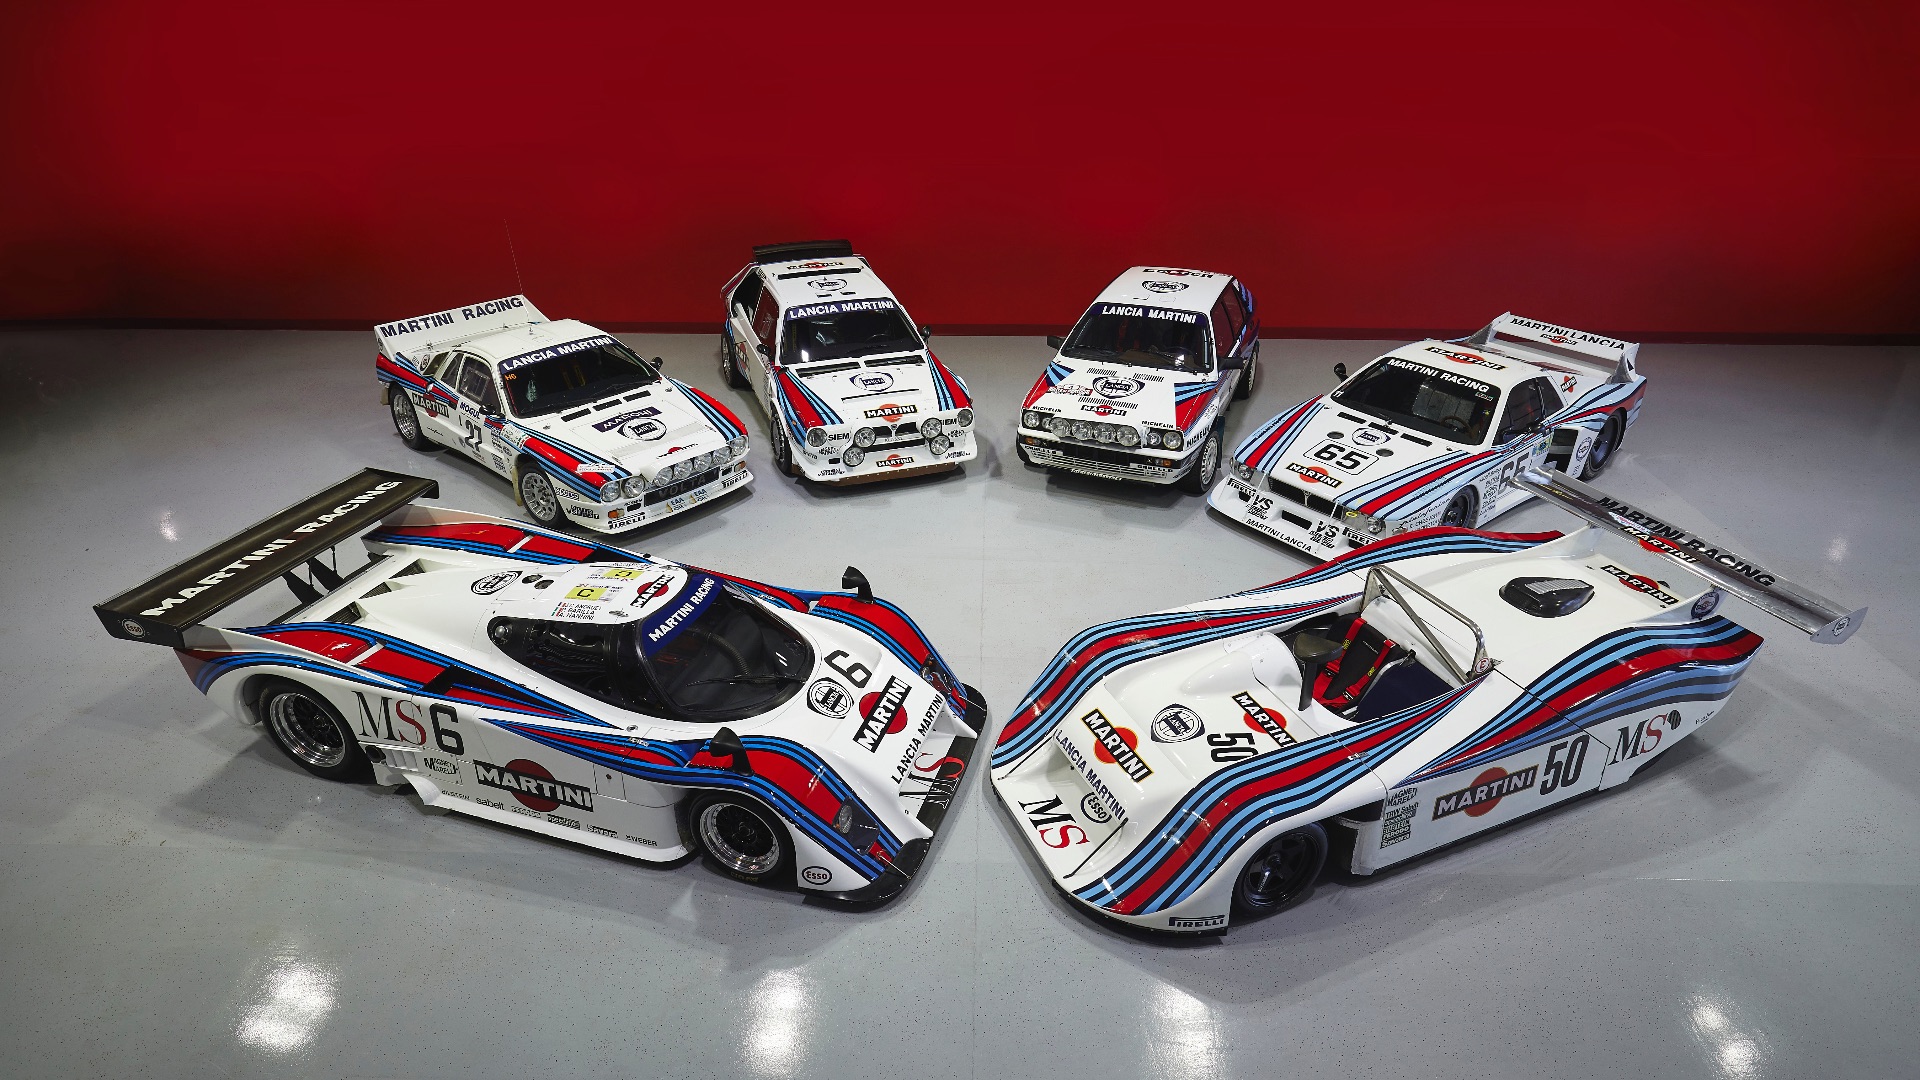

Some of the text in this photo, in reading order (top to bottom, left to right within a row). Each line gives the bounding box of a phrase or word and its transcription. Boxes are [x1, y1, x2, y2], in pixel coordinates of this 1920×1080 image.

[380, 297, 524, 337] MARTINI RACING
[789, 300, 894, 319] LANCIA MARTINI
[1102, 305, 1197, 324] LANCIA MARTINI
[1510, 318, 1625, 350] MARTINI LANCIA
[503, 336, 613, 370] LANCIA MARTINI
[1387, 358, 1490, 393] MARTINI RACING
[413, 394, 448, 417] MARTINI
[460, 402, 480, 419] MOGUL
[866, 405, 916, 418] MARTINI
[1084, 405, 1125, 416] MARTINI
[828, 432, 850, 441] SIEM
[1142, 420, 1174, 429] MICHELIN
[876, 457, 914, 467] MARTINI
[1314, 443, 1369, 470] 65
[658, 476, 706, 497] VOLTA
[1289, 463, 1340, 488] MARTINI
[1253, 494, 1273, 510] VS
[1246, 518, 1281, 538] MARTINI
[1281, 533, 1312, 552] LANCIA
[1317, 521, 1339, 538] VS
[1597, 497, 1776, 587] MARTINI RACING
[1624, 526, 1698, 563] MARTINI
[140, 481, 403, 617] MARTINI RACING
[576, 588, 594, 598] C
[634, 574, 674, 608] MARTINI
[1603, 565, 1677, 604] MARTINI
[648, 577, 715, 642] MARTINI RACING
[824, 650, 872, 688] 6
[351, 690, 427, 745] MS
[429, 702, 465, 755] 6
[856, 677, 909, 751] MARTINI
[1235, 692, 1300, 747] MARTINI
[891, 692, 944, 785] LANCIA MARTINI
[1085, 711, 1148, 779] MARTINI
[1206, 732, 1258, 762] 50
[1608, 714, 1669, 766] MS
[899, 753, 965, 809] MS
[1055, 729, 1126, 820] LANCIA MARTINI
[1540, 735, 1590, 796] 50
[478, 765, 593, 808] MARTINI
[1437, 768, 1536, 816] MARTINI
[476, 797, 505, 811] sabelt
[1018, 794, 1090, 848] MS
[1168, 915, 1225, 928] PIRELLI
